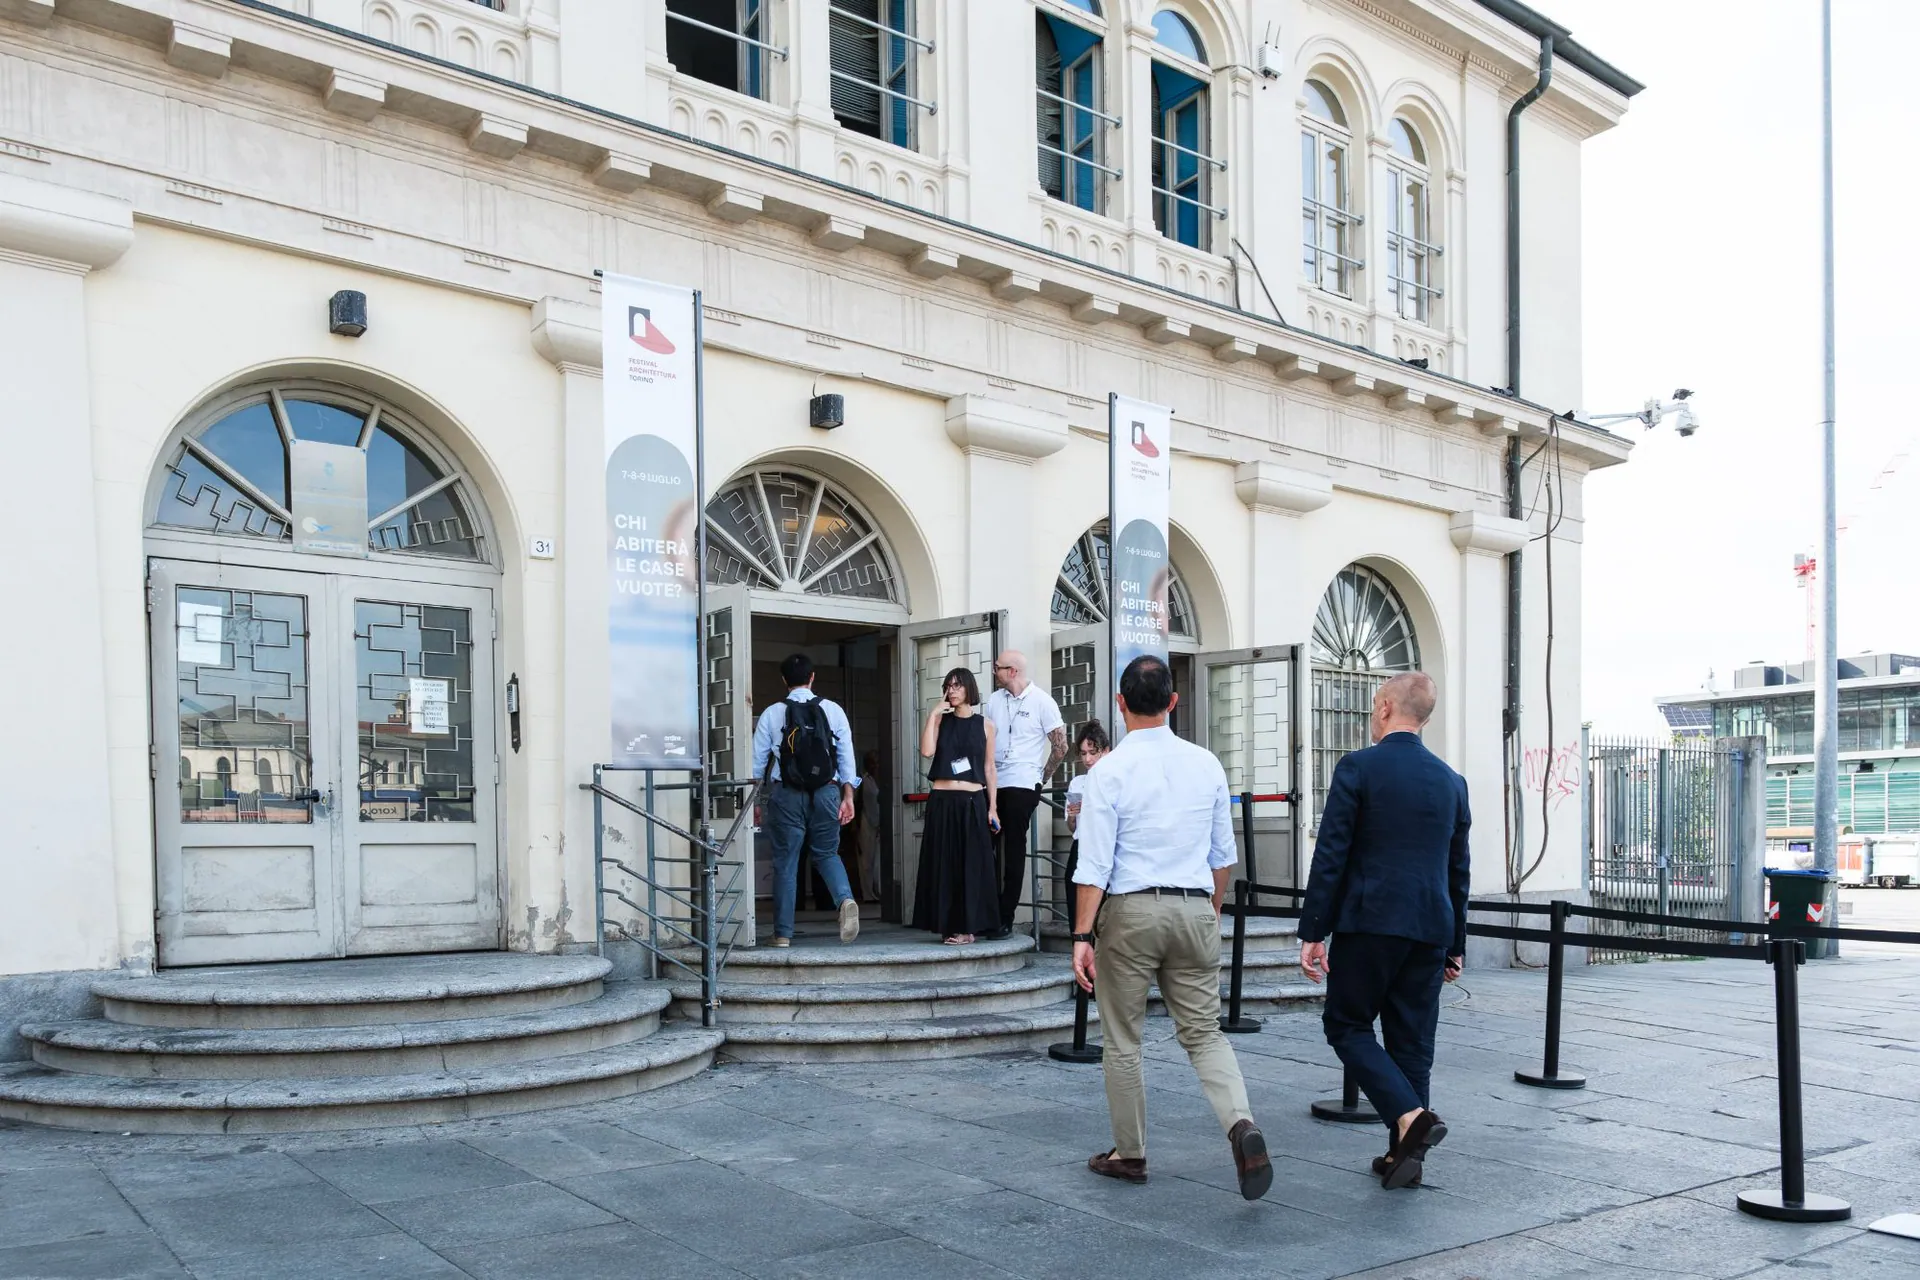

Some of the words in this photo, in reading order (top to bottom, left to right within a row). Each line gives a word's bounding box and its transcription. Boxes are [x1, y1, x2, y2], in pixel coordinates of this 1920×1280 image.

[628, 357, 658, 368] FESTIVAL
[629, 366, 677, 380] ARCHITETTURA
[629, 374, 654, 384] TORINO
[621, 470, 646, 481] 7-8-9
[647, 475, 681, 485] LUGLIO
[615, 514, 647, 531] CHI
[536, 540, 550, 554] 31
[615, 535, 689, 557] ABITERÀ
[616, 557, 637, 573] LE
[639, 559, 685, 577] CASE
[616, 579, 682, 598] VUOTE?
[1120, 580, 1140, 594] CHI
[1121, 614, 1133, 626] LE
[1134, 615, 1163, 630] CASE
[1121, 630, 1161, 646] VUOTE?
